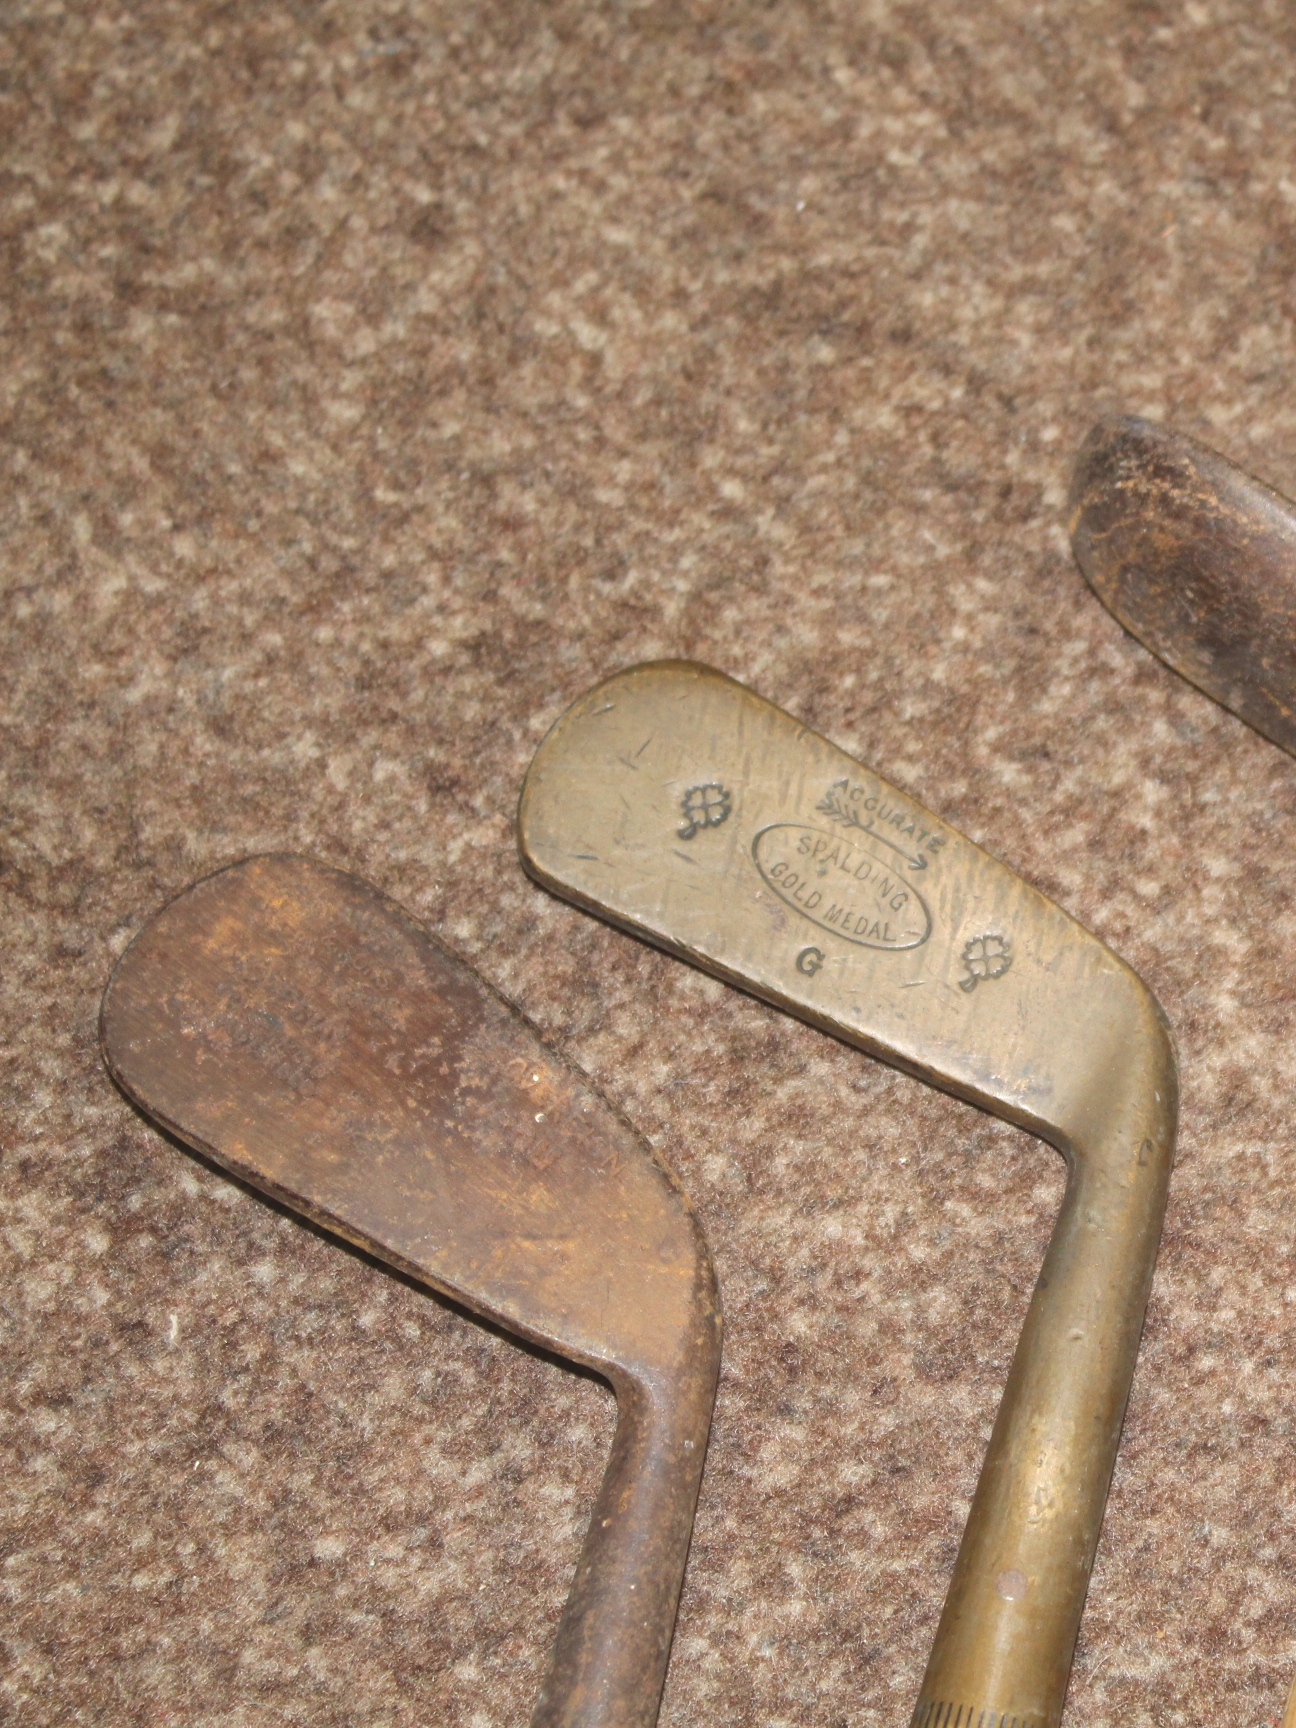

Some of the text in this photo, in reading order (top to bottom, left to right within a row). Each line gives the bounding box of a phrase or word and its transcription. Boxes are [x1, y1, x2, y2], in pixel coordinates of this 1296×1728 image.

[832, 778, 948, 855] ACCURATE
[770, 861, 897, 943] GOLD MEDAL
[796, 834, 909, 914] SPALDING
[796, 946, 826, 978] G
